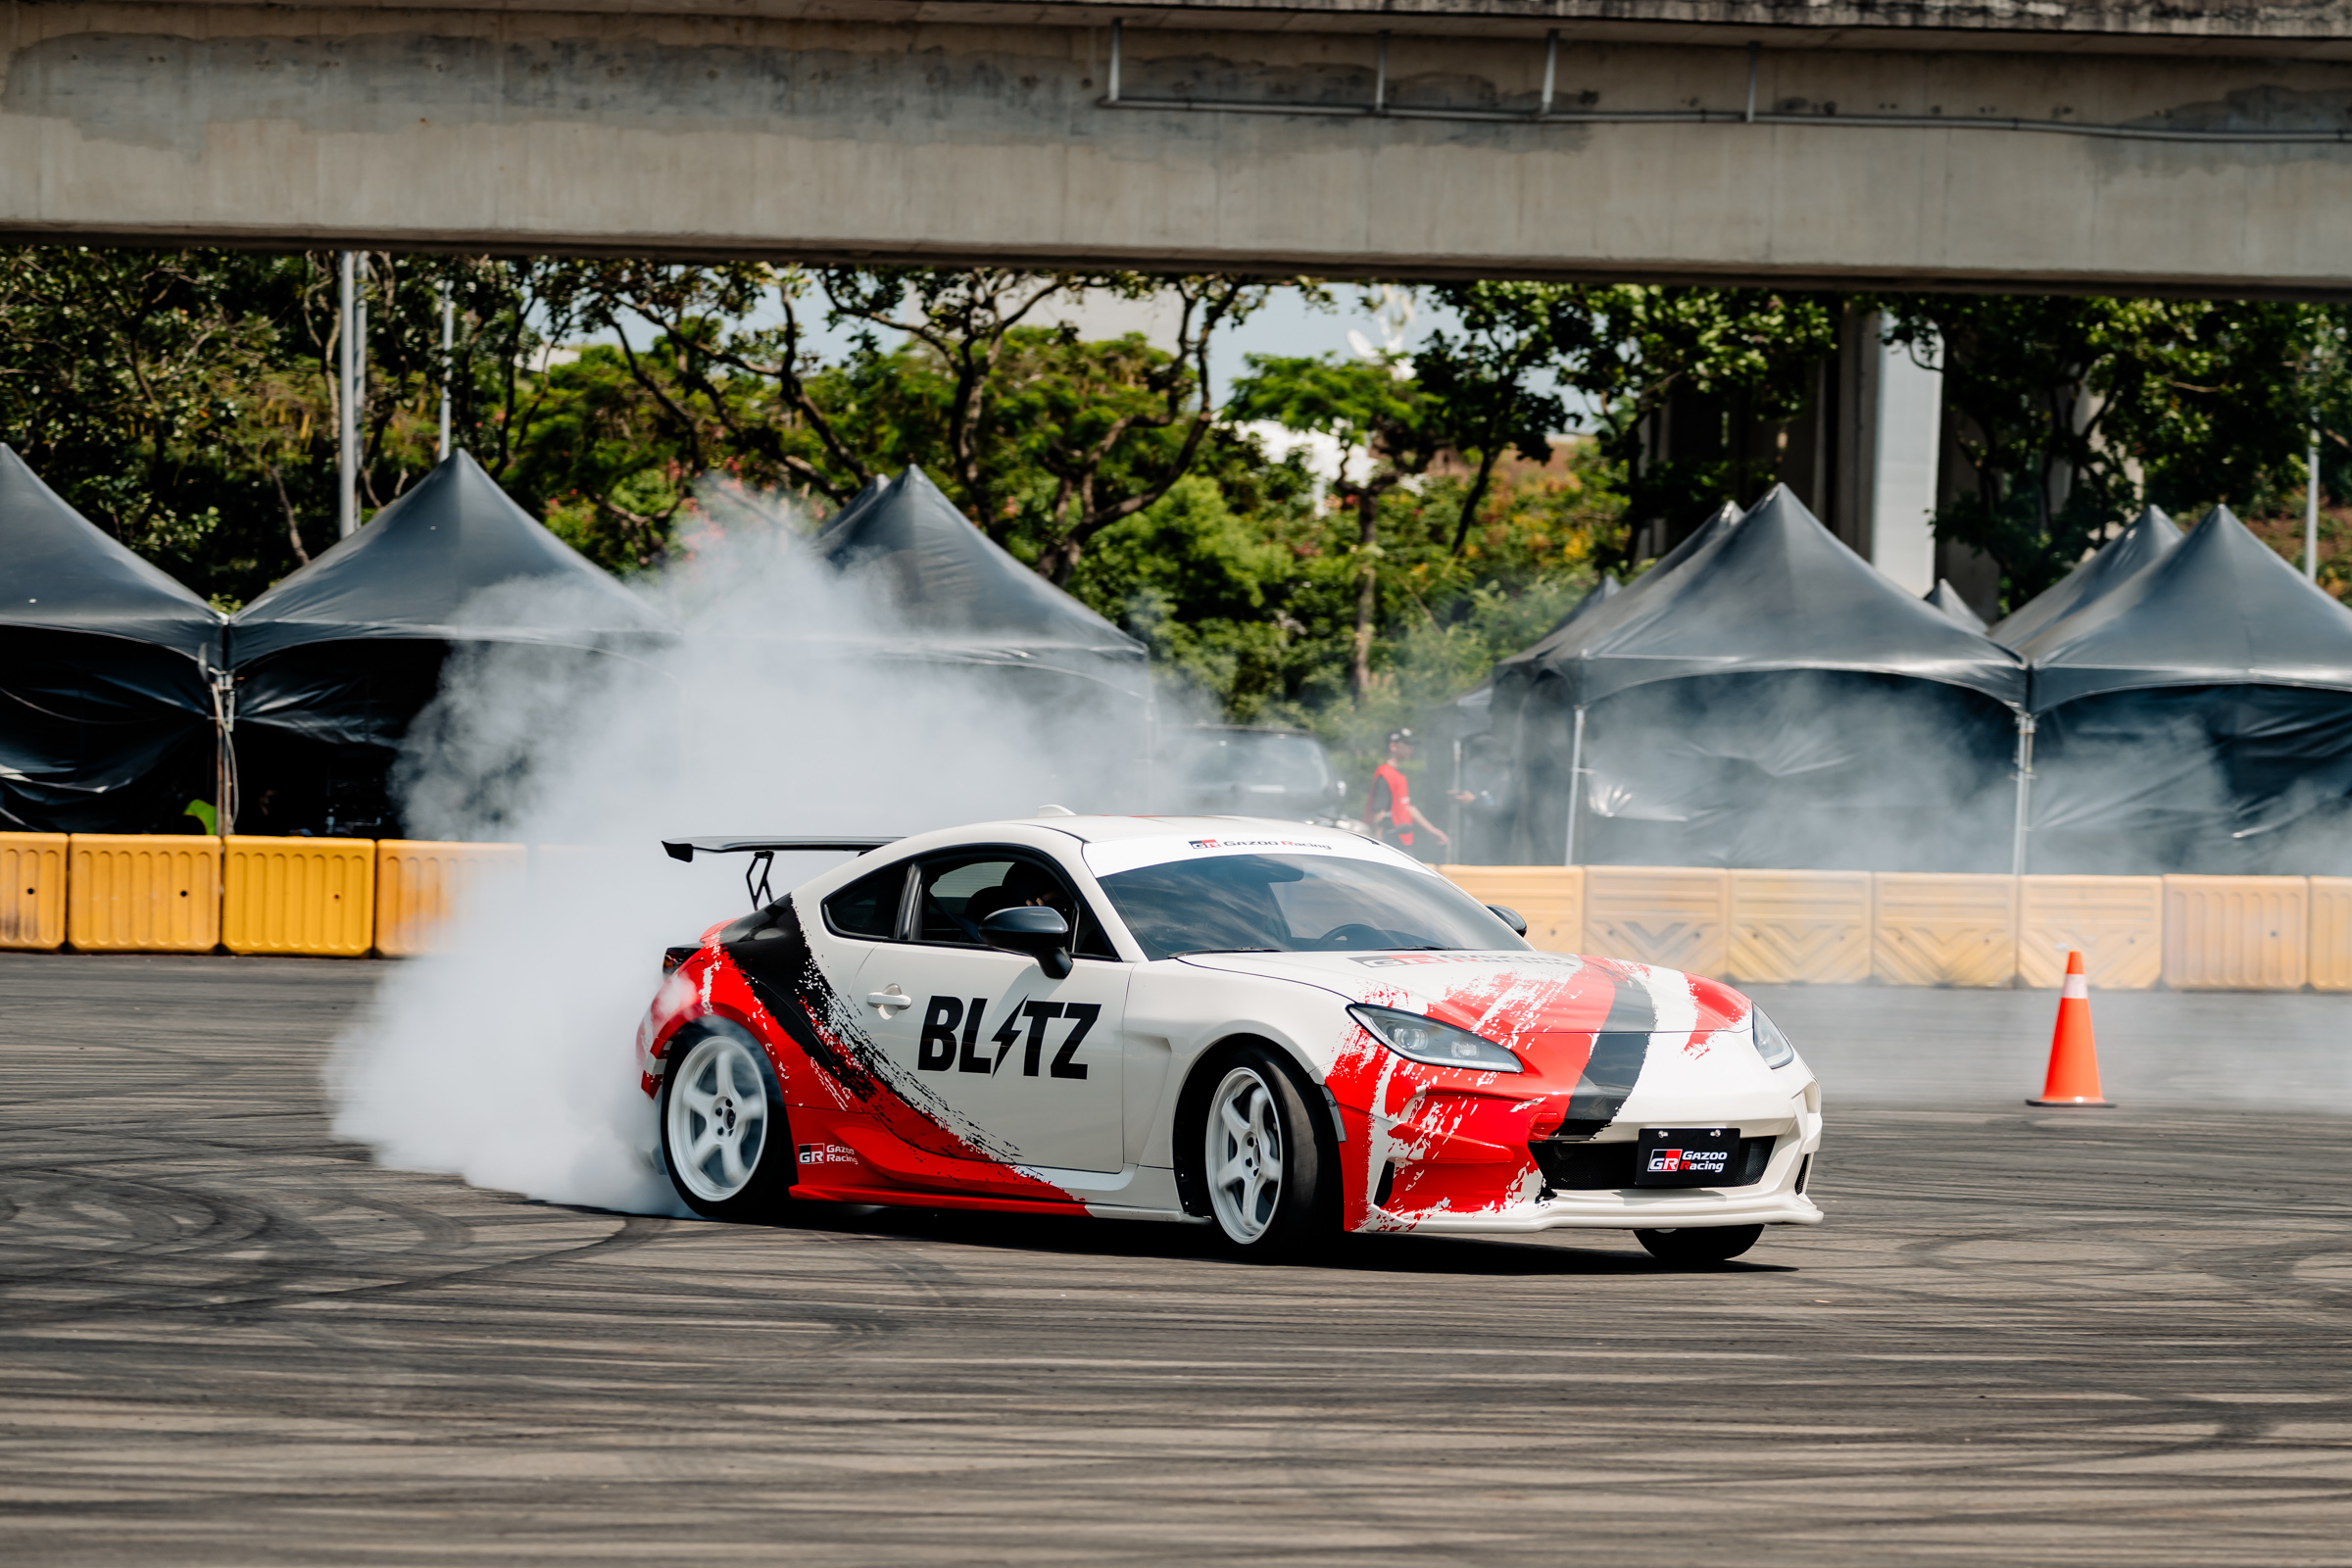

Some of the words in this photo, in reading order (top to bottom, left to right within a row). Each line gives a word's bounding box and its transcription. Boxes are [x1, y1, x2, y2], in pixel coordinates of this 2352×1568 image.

[1281, 840, 1333, 850] Racing
[1361, 956, 1440, 967] GR
[917, 993, 1102, 1080] BLITZ
[799, 1151, 823, 1163] GR
[826, 1153, 858, 1165] Racing
[1649, 1157, 1679, 1170] GR
[1680, 1160, 1725, 1173] Racing
